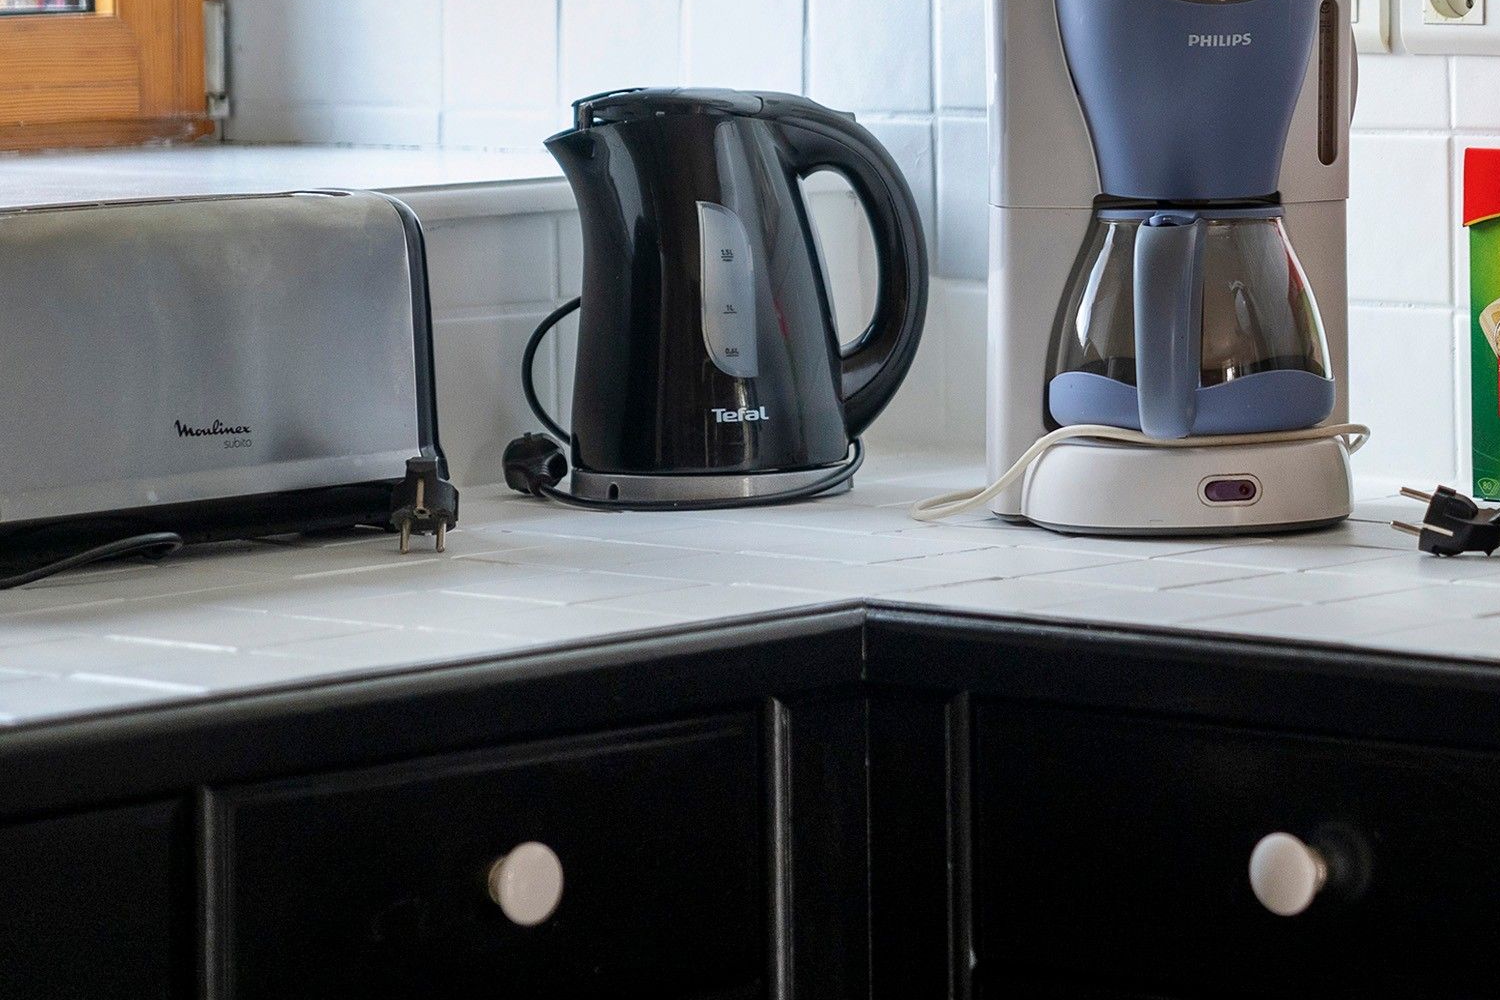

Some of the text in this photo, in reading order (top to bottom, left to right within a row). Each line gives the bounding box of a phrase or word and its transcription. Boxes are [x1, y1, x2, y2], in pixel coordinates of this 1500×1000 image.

[1188, 32, 1252, 47] PHILIPS
[711, 406, 769, 423] Tefal
[174, 419, 252, 438] Moulinex
